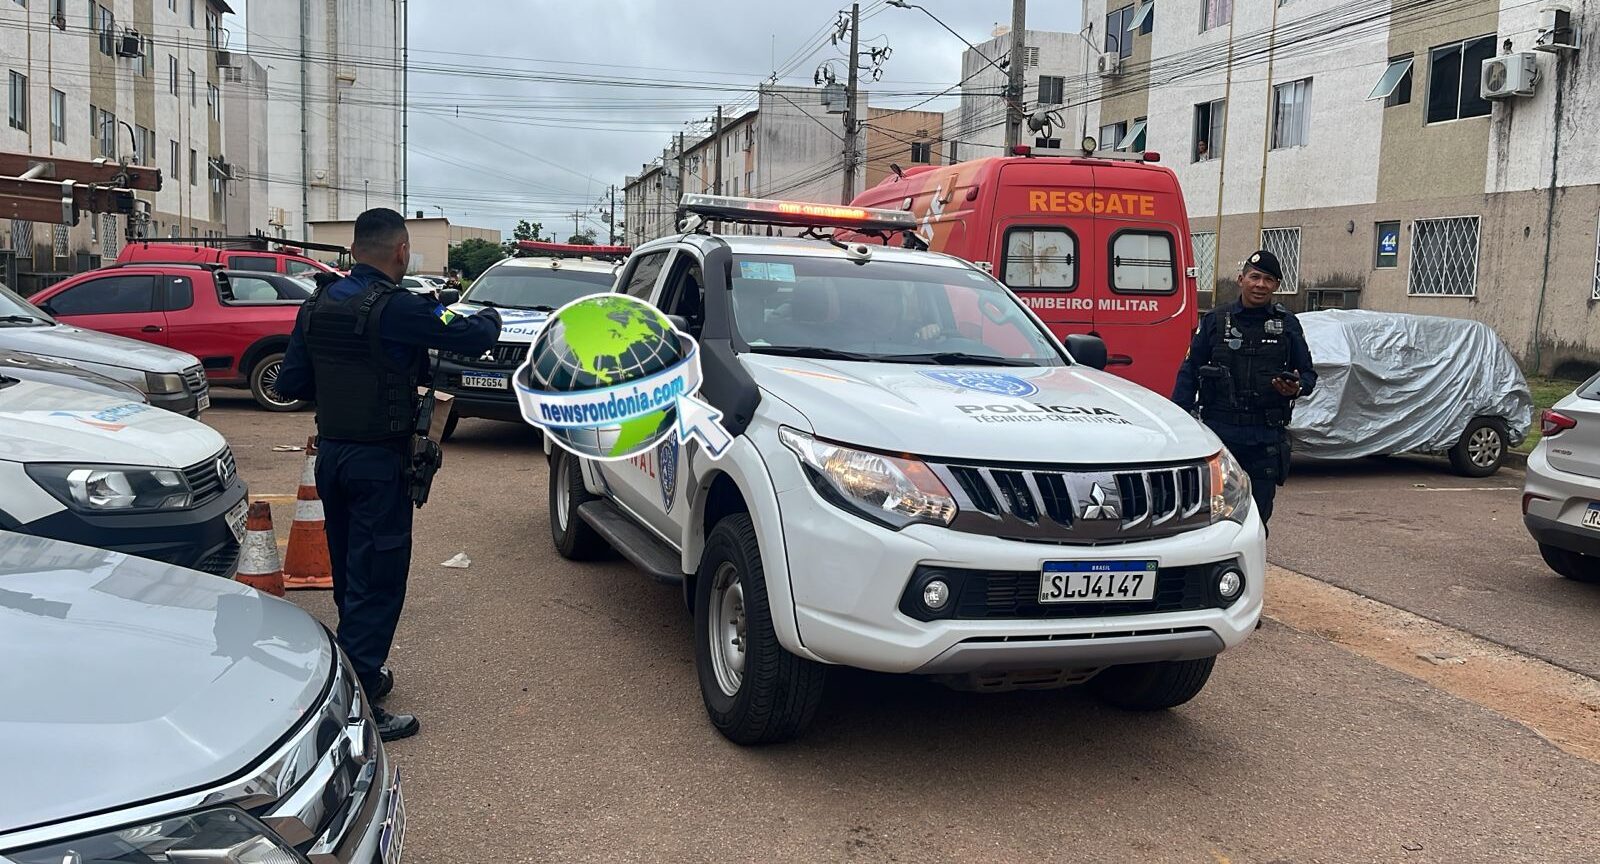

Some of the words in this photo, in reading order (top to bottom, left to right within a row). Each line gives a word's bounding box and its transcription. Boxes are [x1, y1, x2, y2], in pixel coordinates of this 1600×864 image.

[1029, 190, 1155, 216] RESGATE
[1382, 235, 1396, 247] 44
[1020, 297, 1093, 310] OMBEIRO
[1099, 299, 1158, 311] MILITAR
[955, 403, 1121, 416] POLÍCIA
[969, 414, 1134, 425] TÉCNICO-CIENTÍFICA
[1050, 574, 1144, 598] SLJ4147
